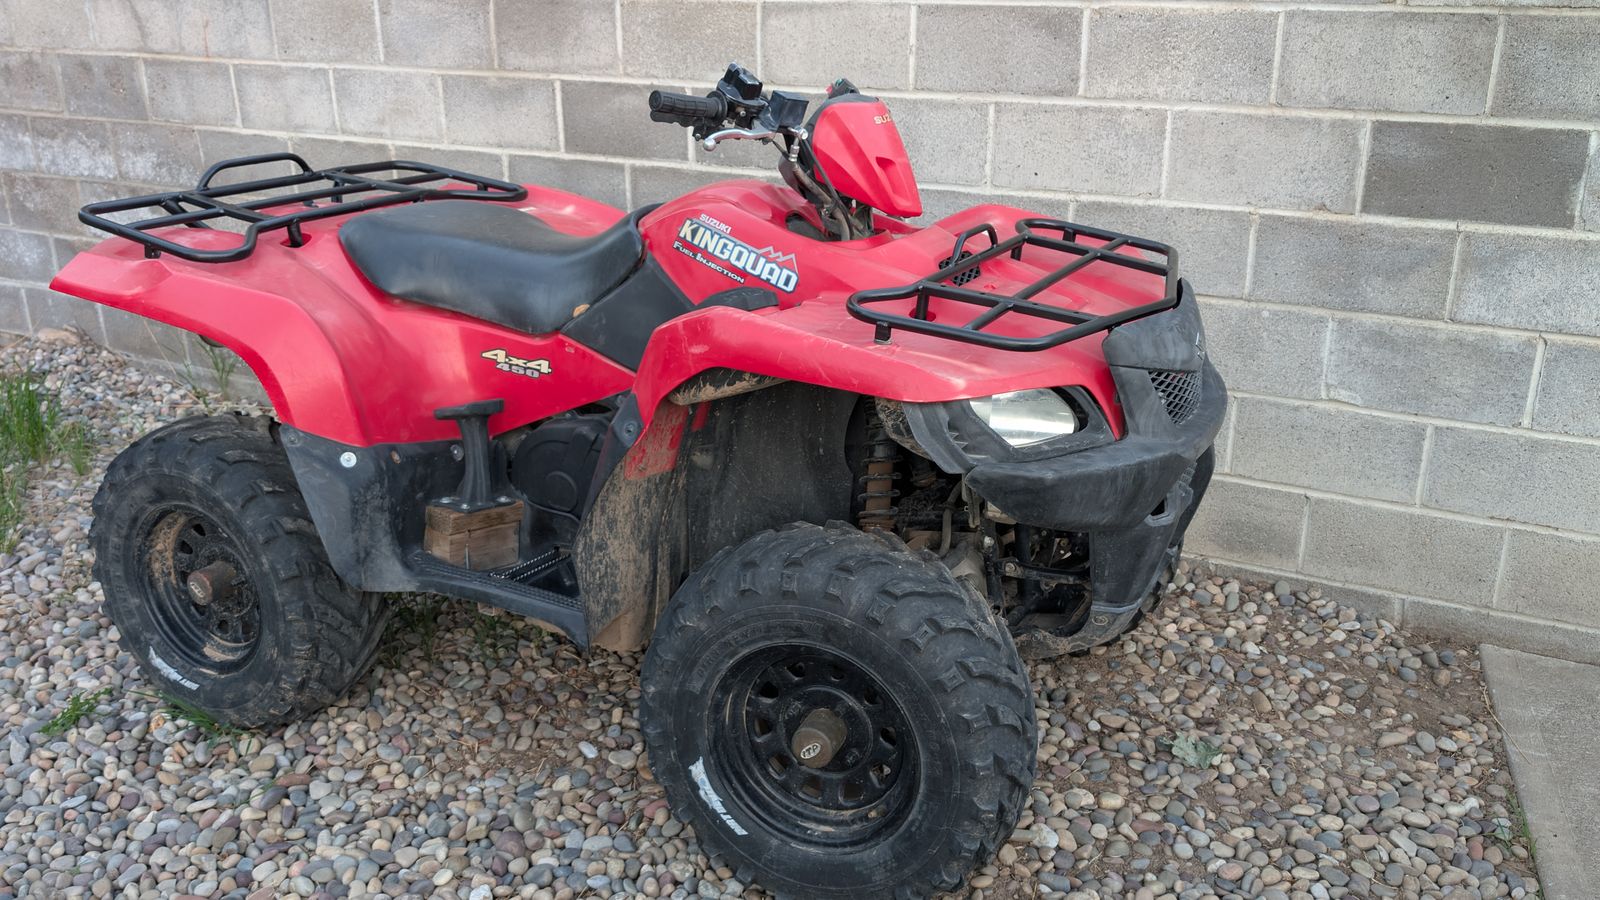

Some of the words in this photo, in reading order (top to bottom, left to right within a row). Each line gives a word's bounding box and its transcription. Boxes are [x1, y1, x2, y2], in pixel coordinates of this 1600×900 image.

[873, 113, 892, 124] SUZ
[699, 213, 732, 234] SUZUKI
[672, 240, 697, 259] FUEL
[695, 251, 745, 284] INJECTION
[678, 219, 799, 293] KINGQUAD
[481, 349, 552, 374] 4x4
[495, 362, 540, 378] 450
[802, 744, 819, 758] ITP
